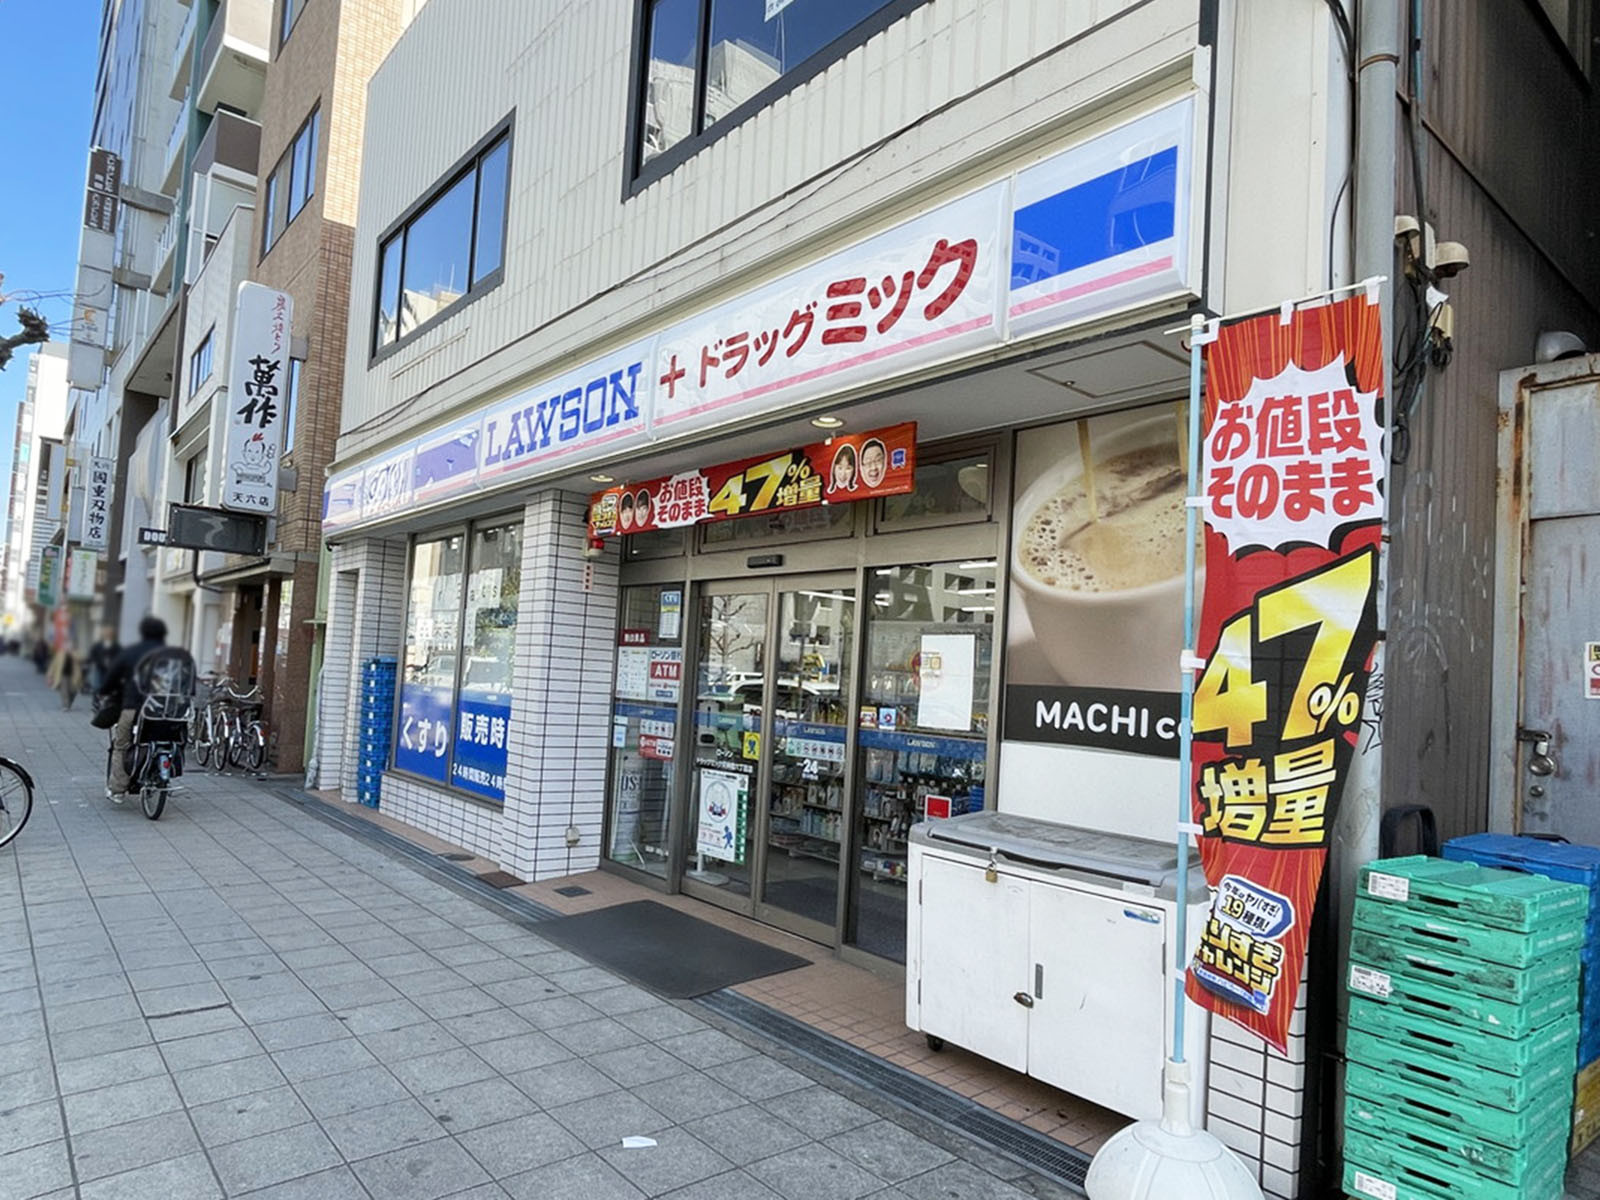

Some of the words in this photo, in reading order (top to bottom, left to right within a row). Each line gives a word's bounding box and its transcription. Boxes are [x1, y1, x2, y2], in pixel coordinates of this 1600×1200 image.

[236, 354, 281, 428] 萬作
[485, 361, 642, 466] LAWSON
[1211, 388, 1367, 462] お値段
[233, 492, 269, 506] 天六店
[659, 477, 703, 502] お値段
[709, 454, 811, 515] 47%
[777, 475, 822, 506] 増量
[1208, 457, 1374, 522] そのまま
[656, 503, 706, 523] そのまま
[1192, 550, 1373, 748] 47%
[655, 664, 677, 677] ATM
[402, 716, 448, 757] くすり
[460, 711, 505, 749] 販売時
[1036, 699, 1148, 738] MACHI
[802, 759, 819, 774] 24
[1200, 738, 1336, 843] 増量
[1201, 918, 1281, 976] りすぎ
